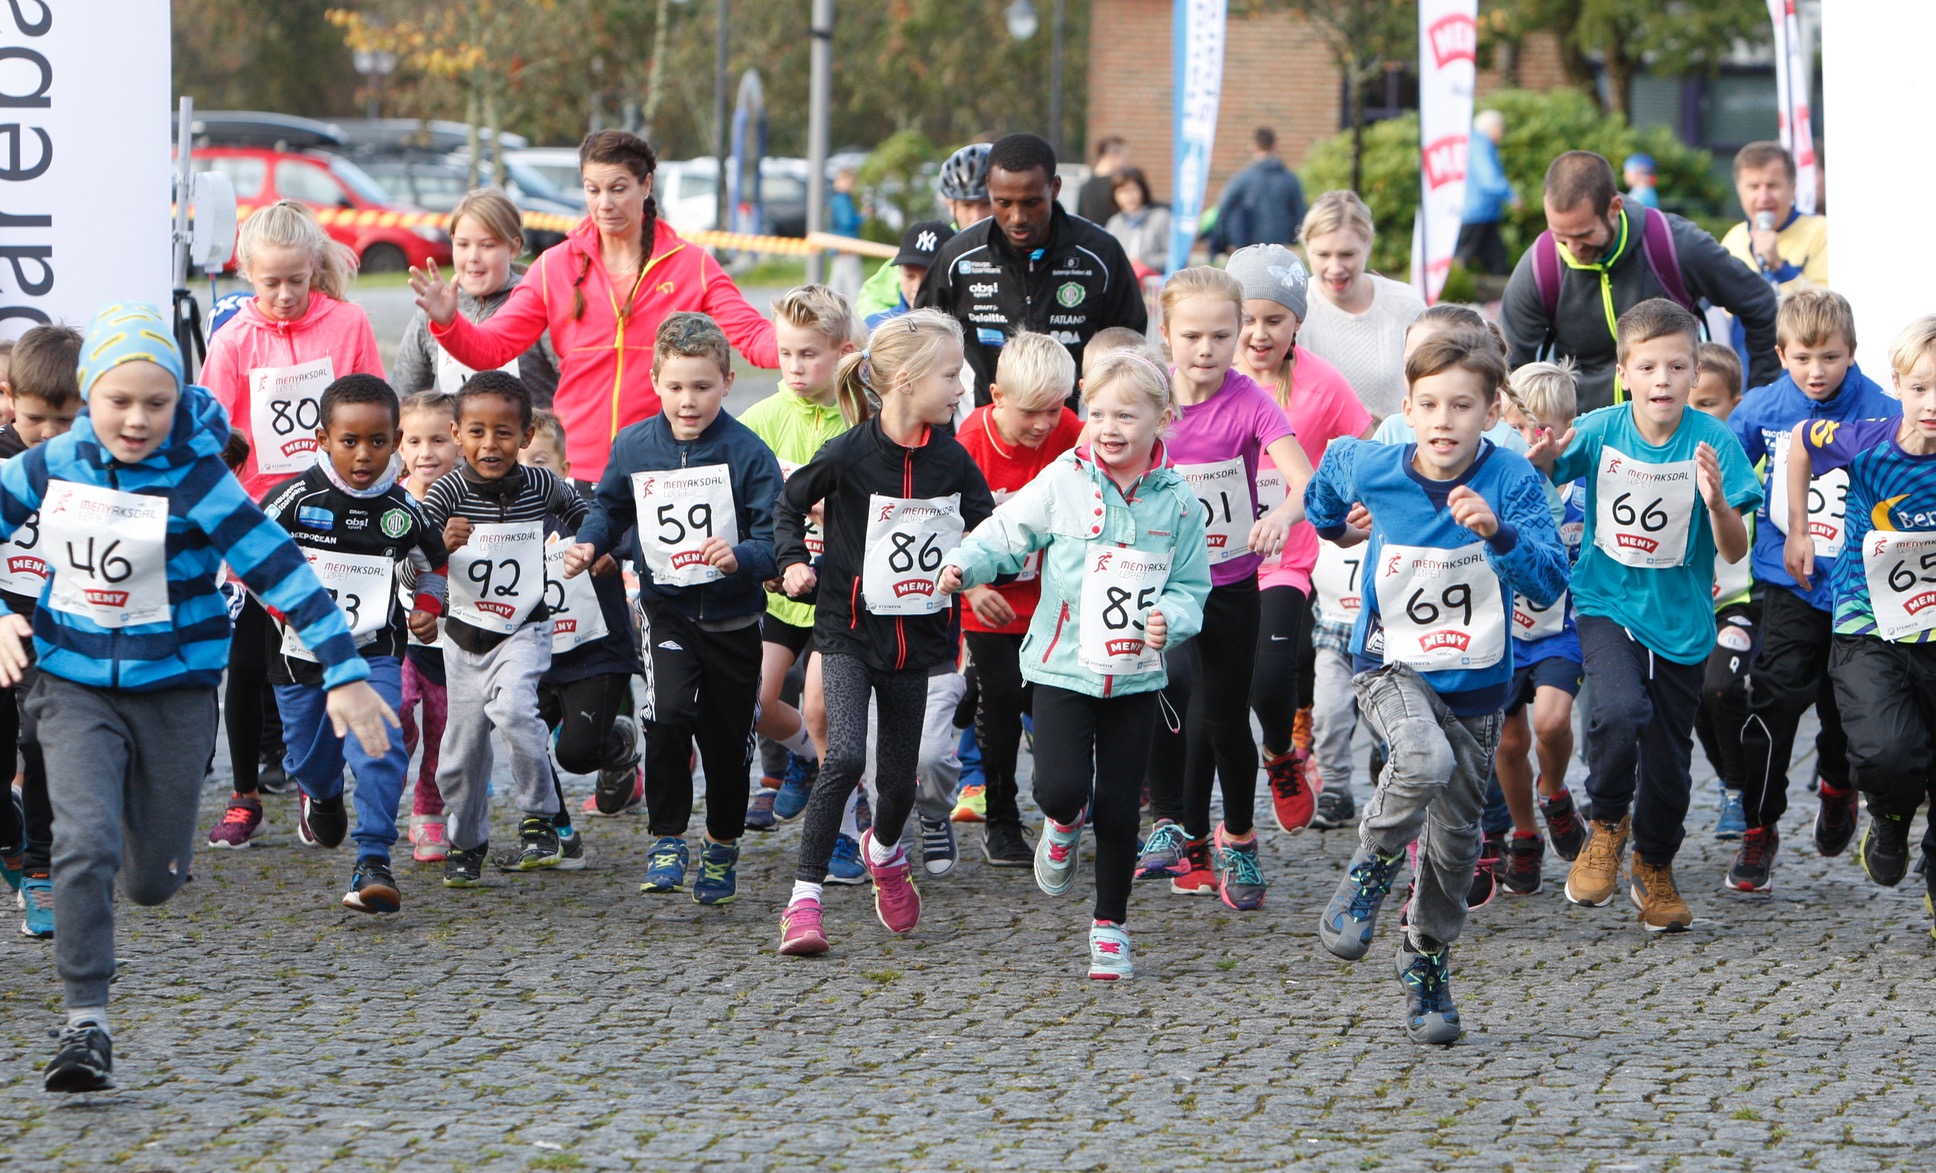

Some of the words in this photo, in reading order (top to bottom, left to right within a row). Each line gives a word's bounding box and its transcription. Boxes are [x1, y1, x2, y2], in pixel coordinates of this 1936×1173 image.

[969, 282, 998, 293] obs!
[1050, 315, 1086, 324] FATLAND
[275, 368, 328, 386] MENYAKSDAL
[270, 398, 321, 436] 80
[285, 441, 316, 454] MENY
[1627, 468, 1689, 482] MENYAKSDAL
[663, 477, 723, 490] MENYAKSDAL
[80, 500, 157, 519] MENYAKSDAL
[1612, 492, 1668, 532] 66
[345, 518, 368, 527] obs!
[657, 503, 712, 545] 59
[480, 532, 537, 543] MENYAKSDAL
[1207, 537, 1223, 546] NY
[1619, 536, 1655, 549] MENY
[888, 532, 943, 573] 86
[67, 537, 132, 583] 46
[1411, 553, 1485, 570] MENYAKSDAL
[322, 571, 350, 581] LØPET
[324, 562, 385, 577] MENYAKSDAL
[1118, 570, 1147, 581] LØPET
[468, 558, 521, 599] 92
[898, 581, 933, 594] MENY
[478, 603, 511, 615] MENY
[1102, 586, 1156, 632] 85
[1405, 583, 1472, 626] 69
[1110, 641, 1143, 653] MENY
[1423, 633, 1467, 648] MENY
